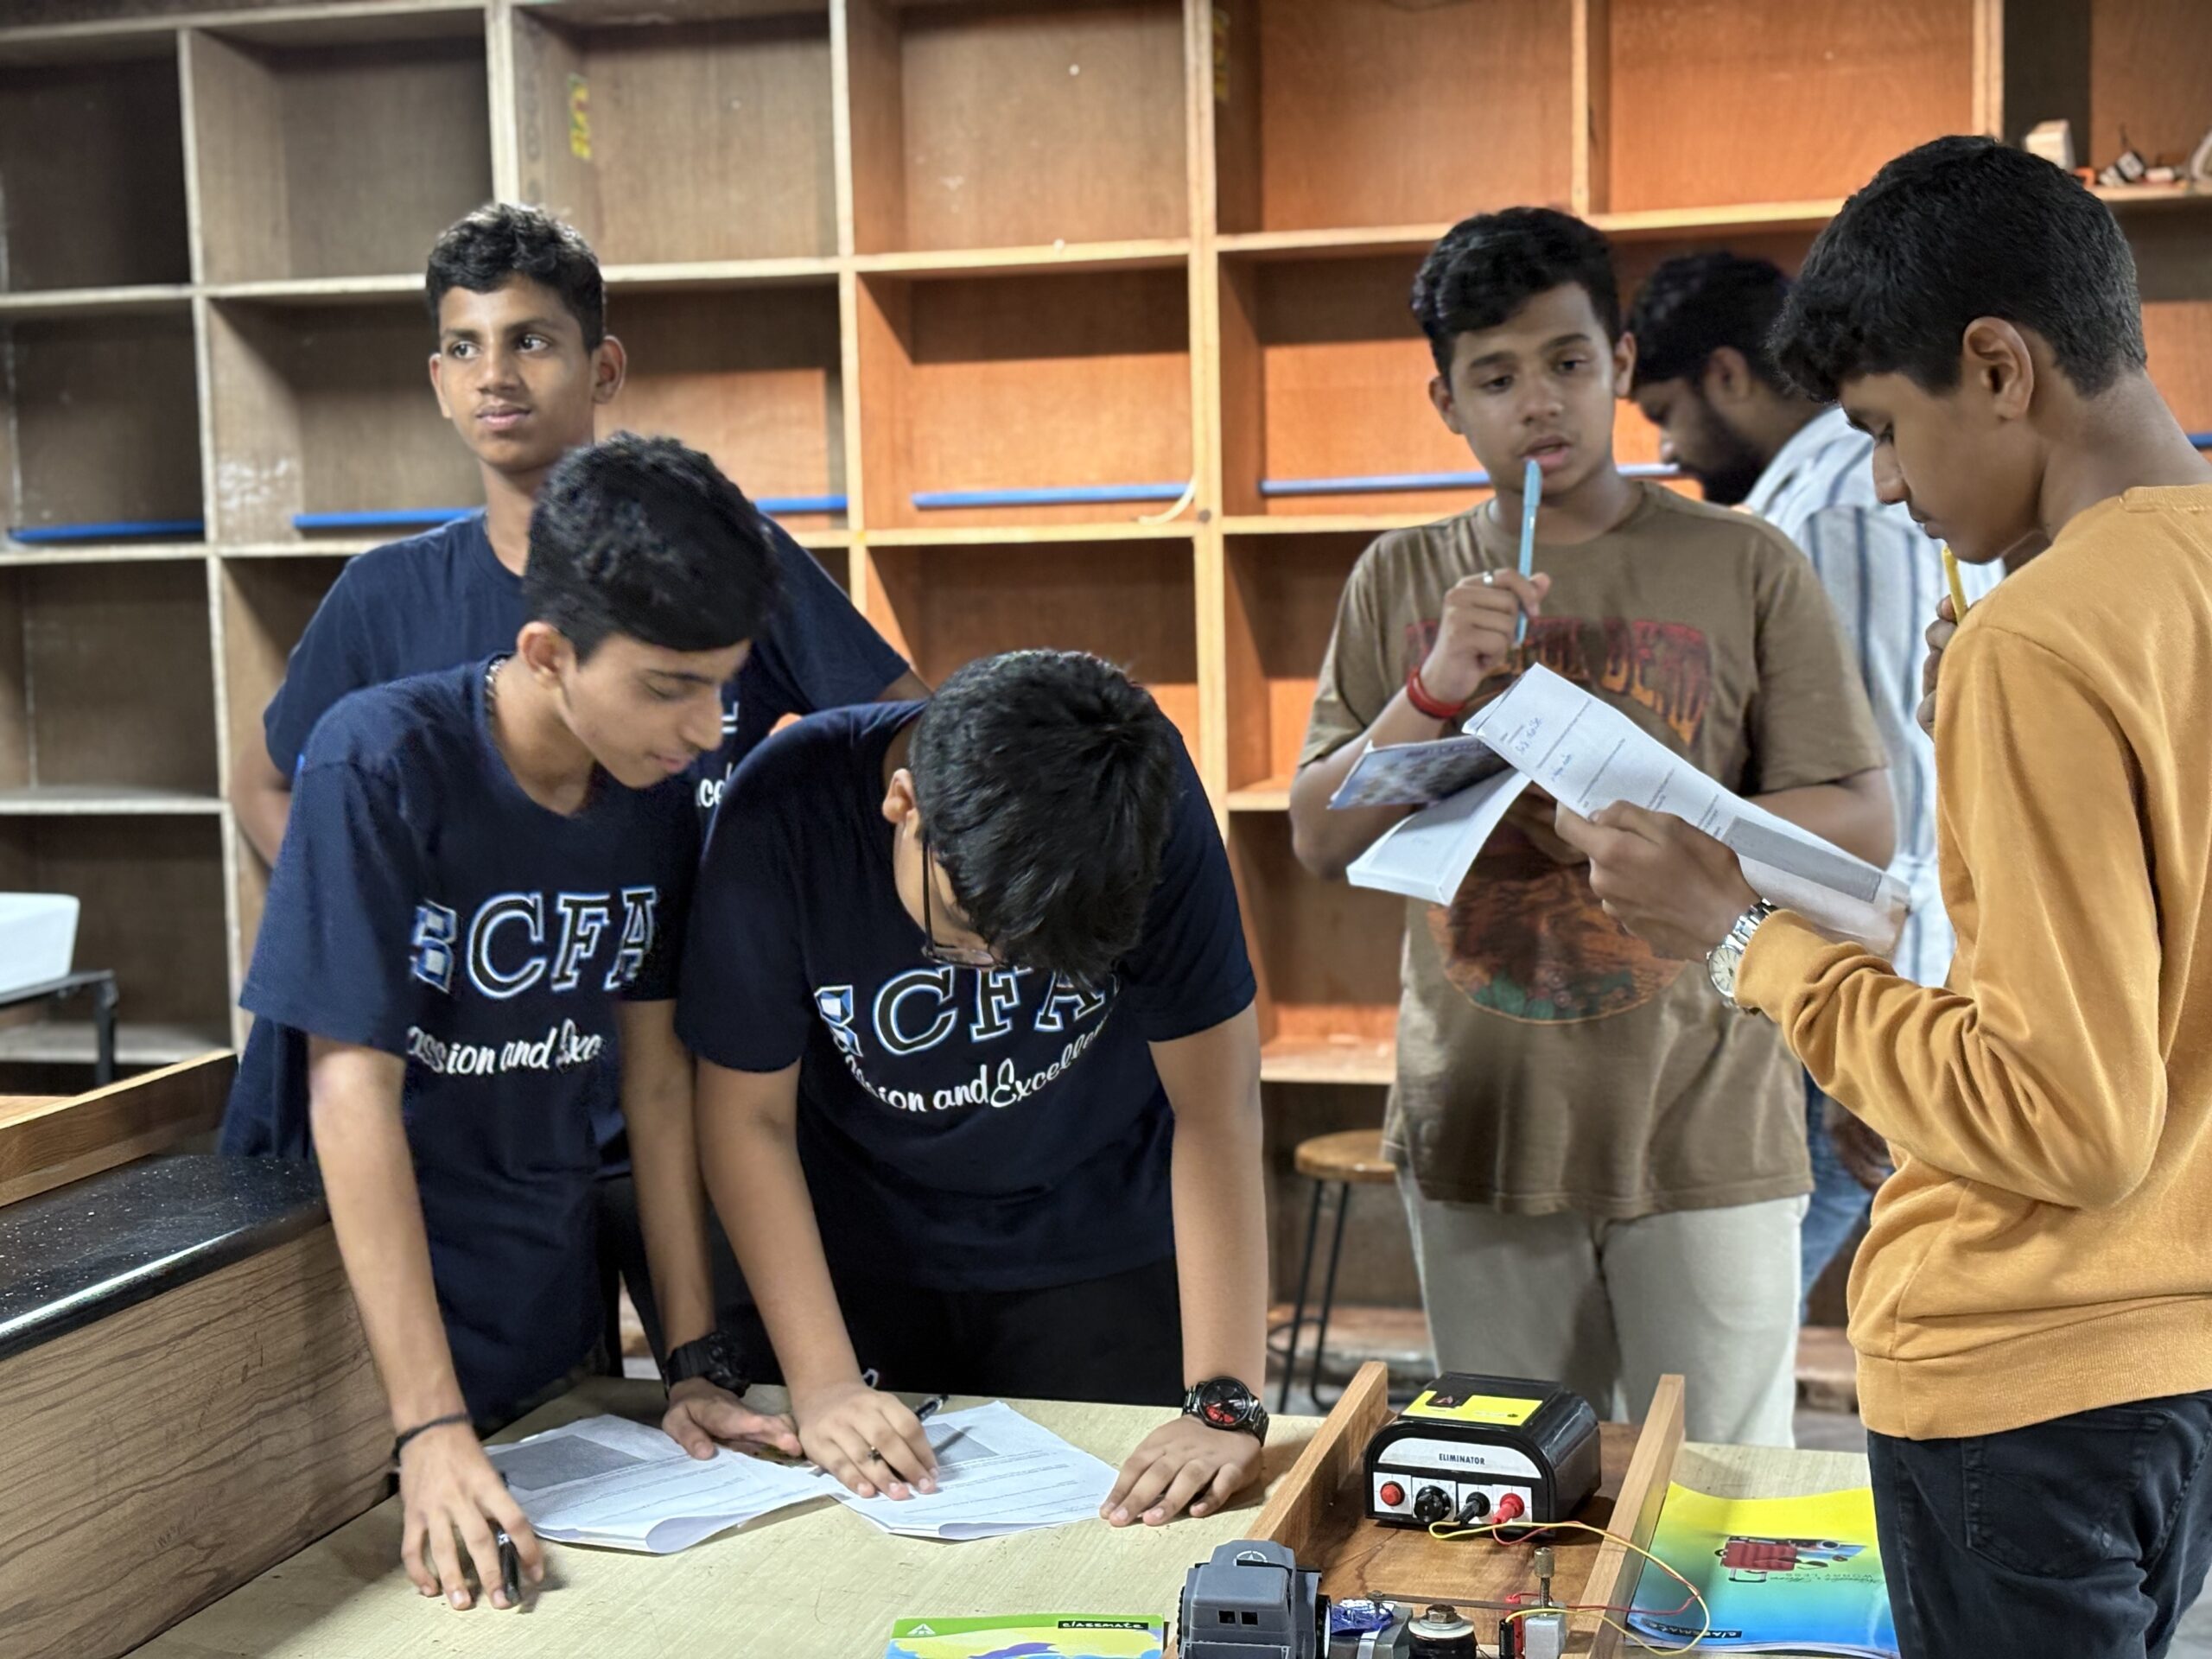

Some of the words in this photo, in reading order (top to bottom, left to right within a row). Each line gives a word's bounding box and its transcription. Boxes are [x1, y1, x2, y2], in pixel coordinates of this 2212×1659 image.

[500, 1027, 558, 1071] and
[933, 1065, 988, 1110] and
[1439, 1453, 1485, 1465] ELIMINATOR
